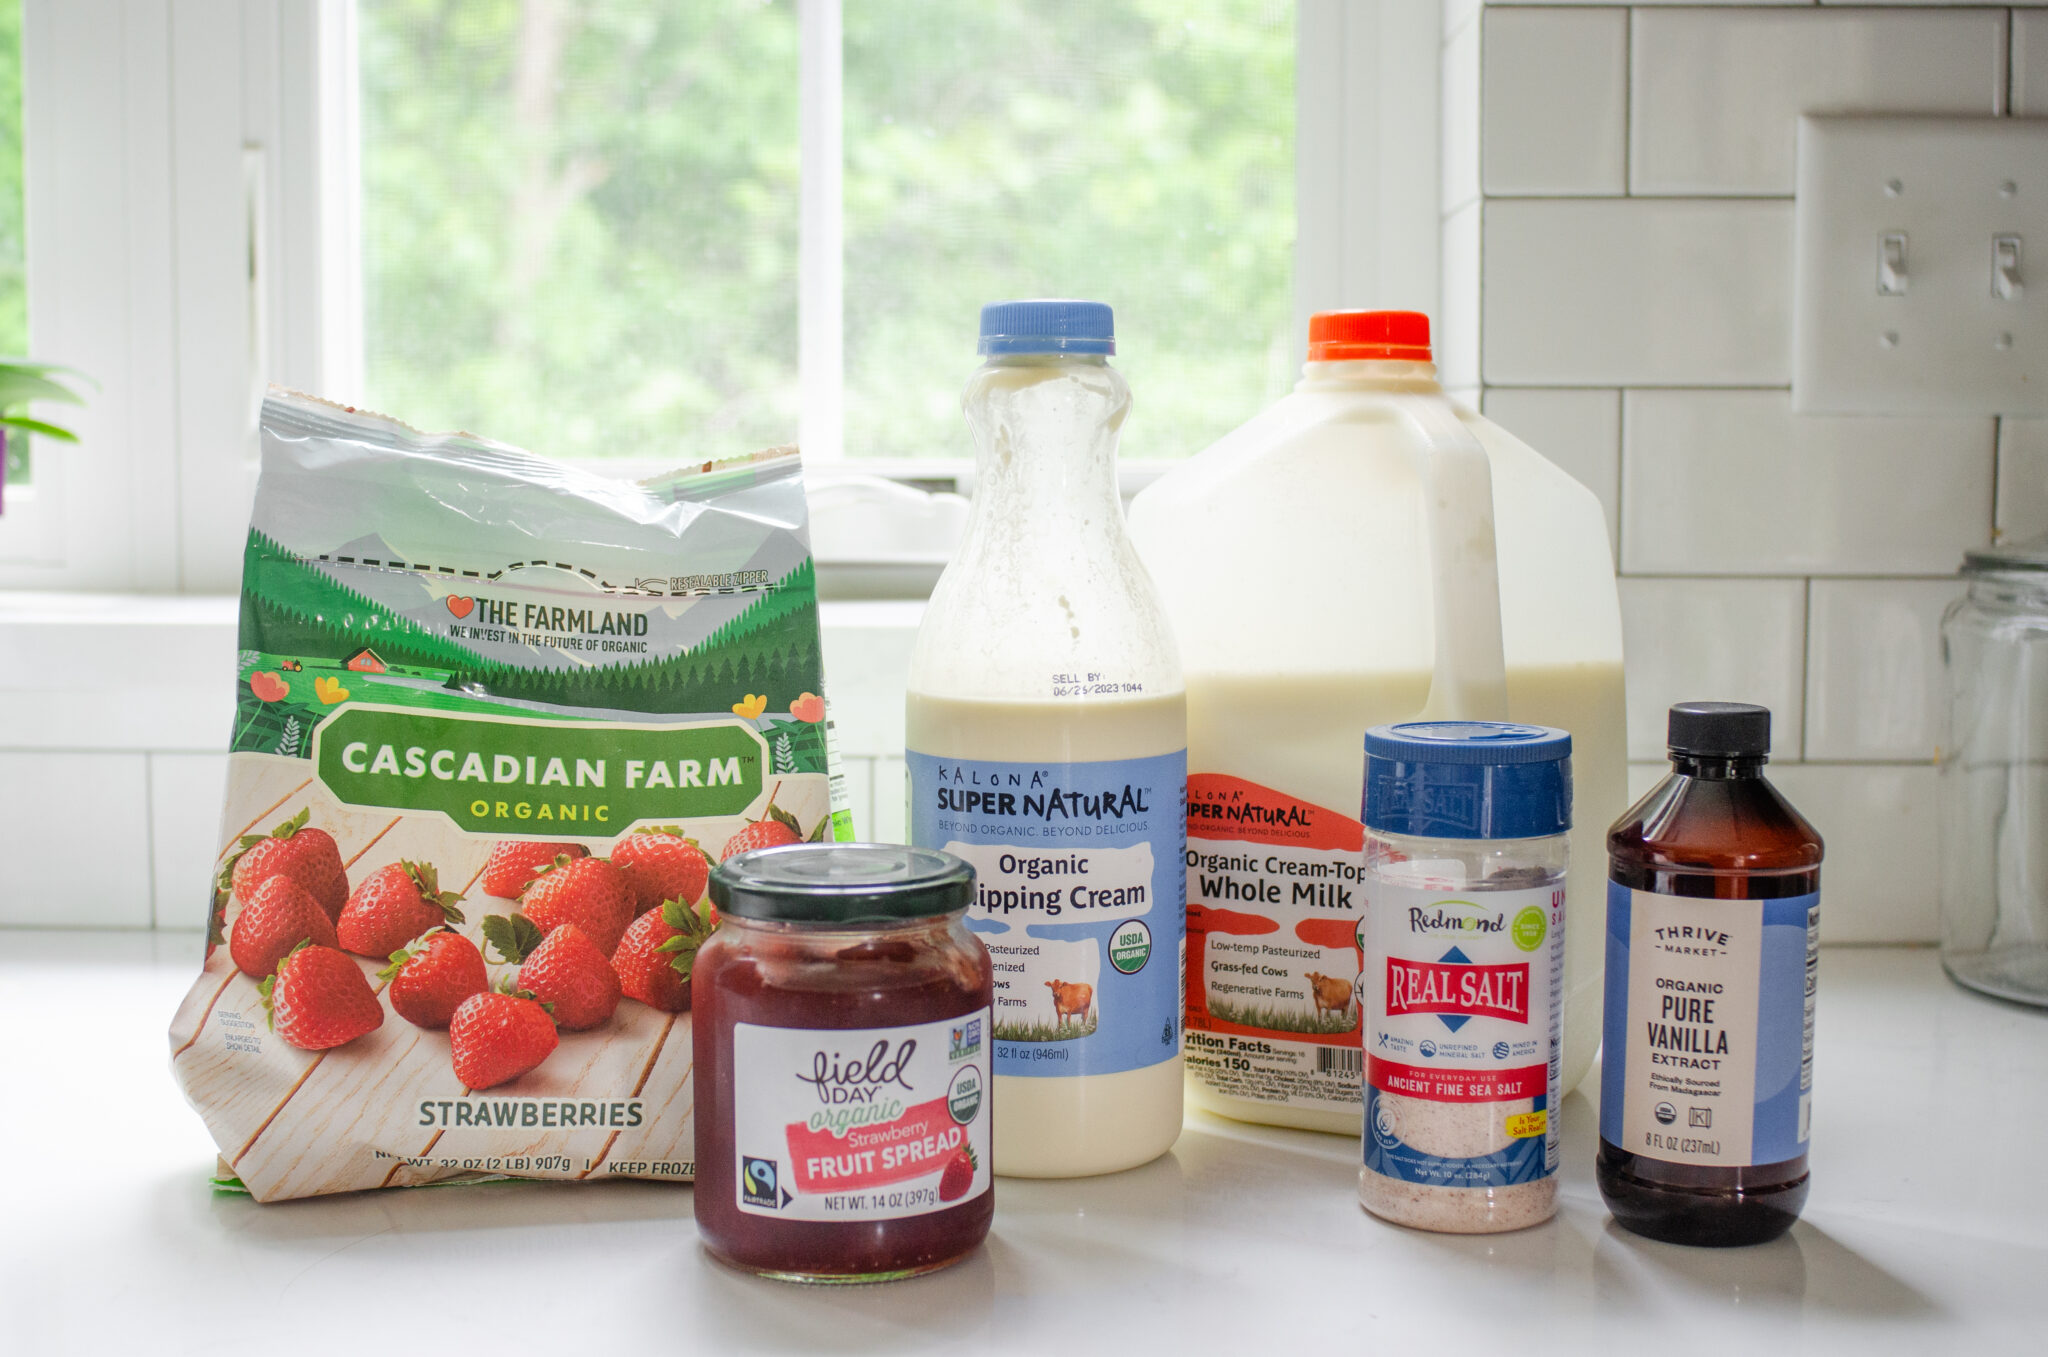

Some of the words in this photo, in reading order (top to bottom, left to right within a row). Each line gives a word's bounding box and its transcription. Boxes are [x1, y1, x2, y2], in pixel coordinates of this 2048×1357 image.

[670, 574, 731, 591] RESEALABLE
[732, 570, 768, 585] ZIPPER
[476, 598, 518, 628] THE
[525, 604, 648, 637] FARMLAND
[450, 624, 467, 639] WE
[469, 627, 506, 642] INVEST
[508, 632, 520, 644] IN
[522, 633, 541, 647] THE
[542, 635, 583, 651] FUTURE
[586, 639, 598, 651] OF
[602, 640, 648, 654] ORGANIC
[1052, 673, 1080, 685] SELL
[1121, 683, 1143, 694] 1044
[342, 742, 607, 788] CASCADIAN
[470, 799, 609, 822] ORGANIC
[938, 788, 1017, 816] SUPER
[938, 820, 977, 834] BEYOND
[1042, 826, 1092, 838] BEYOND
[1000, 854, 1089, 880] Organic
[1187, 850, 1259, 874] Organic
[1265, 856, 1366, 885] Cream-Top
[1069, 884, 1146, 911] Cream
[1199, 875, 1281, 904] Whole
[1292, 882, 1353, 910] Milk
[1408, 906, 1506, 934] Redmond
[1119, 931, 1144, 947] USDA
[1654, 926, 1730, 947] THRIVE
[985, 943, 1040, 956] Pasteurized
[1116, 947, 1147, 961] ORGANIC
[1211, 940, 1260, 955] Low-temp
[1262, 944, 1321, 960] Pasteurized
[1664, 944, 1717, 957] MARKET
[1211, 961, 1258, 976] Grass-fed
[1261, 966, 1288, 978] Cows
[1211, 981, 1272, 997] Regenerative
[1275, 987, 1305, 1000] Farms
[1391, 964, 1456, 1011] REAL
[1460, 969, 1523, 1013] SALT
[1655, 977, 1724, 995] ORGANIC
[997, 997, 1027, 1008] Farms
[1661, 995, 1715, 1025] PURE
[1228, 1037, 1271, 1054] Facts
[1439, 1043, 1478, 1052] UNREFINED
[1647, 1021, 1729, 1056] VANILLA
[997, 1046, 1009, 1059] 32
[1011, 1046, 1017, 1059] fl
[1019, 1049, 1030, 1060] oz
[1032, 1047, 1069, 1062] (946ml)
[1391, 1045, 1407, 1054] TASTE
[1439, 1051, 1469, 1060] MINERAL
[1471, 1051, 1486, 1060] SALT
[1223, 1057, 1250, 1072] 150
[1652, 1053, 1722, 1071] EXTRACT
[796, 1039, 917, 1104] field
[1409, 1070, 1425, 1079] FOR
[1429, 1074, 1477, 1083] EVERYDAY
[1480, 1075, 1497, 1083] USE
[1651, 1072, 1683, 1085] Ethically
[1685, 1077, 1721, 1088] Sourced
[957, 1078, 976, 1096] USDA
[1387, 1074, 1431, 1095] ANCIENT
[1436, 1083, 1464, 1096] FINE
[1469, 1084, 1492, 1096] SEA
[1497, 1081, 1523, 1096] SALT
[1649, 1081, 1670, 1091] From
[1671, 1085, 1722, 1097] Madagascar
[419, 1100, 643, 1128] STRAWBERRIES
[810, 1099, 903, 1137] organic
[1519, 1116, 1526, 1126] Is
[1526, 1114, 1541, 1126] Your
[848, 1120, 930, 1149] Strawberry
[1512, 1125, 1528, 1137] Salt
[1645, 1131, 1652, 1147] 8
[1653, 1133, 1665, 1149] FL
[1666, 1136, 1679, 1151] OZ
[1681, 1138, 1721, 1157] (237mL)
[807, 1151, 877, 1181] FRUIT
[882, 1126, 962, 1170] SPREAD
[440, 1158, 459, 1169] 32
[463, 1158, 482, 1170] OZ
[486, 1156, 501, 1170] (2
[506, 1156, 530, 1171] LB)
[535, 1155, 571, 1172] 907g
[608, 1161, 647, 1176] KEEP
[1415, 1167, 1428, 1177] Net
[1443, 1171, 1452, 1179] 10
[1465, 1171, 1491, 1182] (284g)
[825, 1195, 846, 1211] NET
[847, 1195, 868, 1211] WT.
[872, 1194, 885, 1209] 14
[888, 1192, 903, 1208] OZ
[905, 1187, 939, 1208] (397g)
